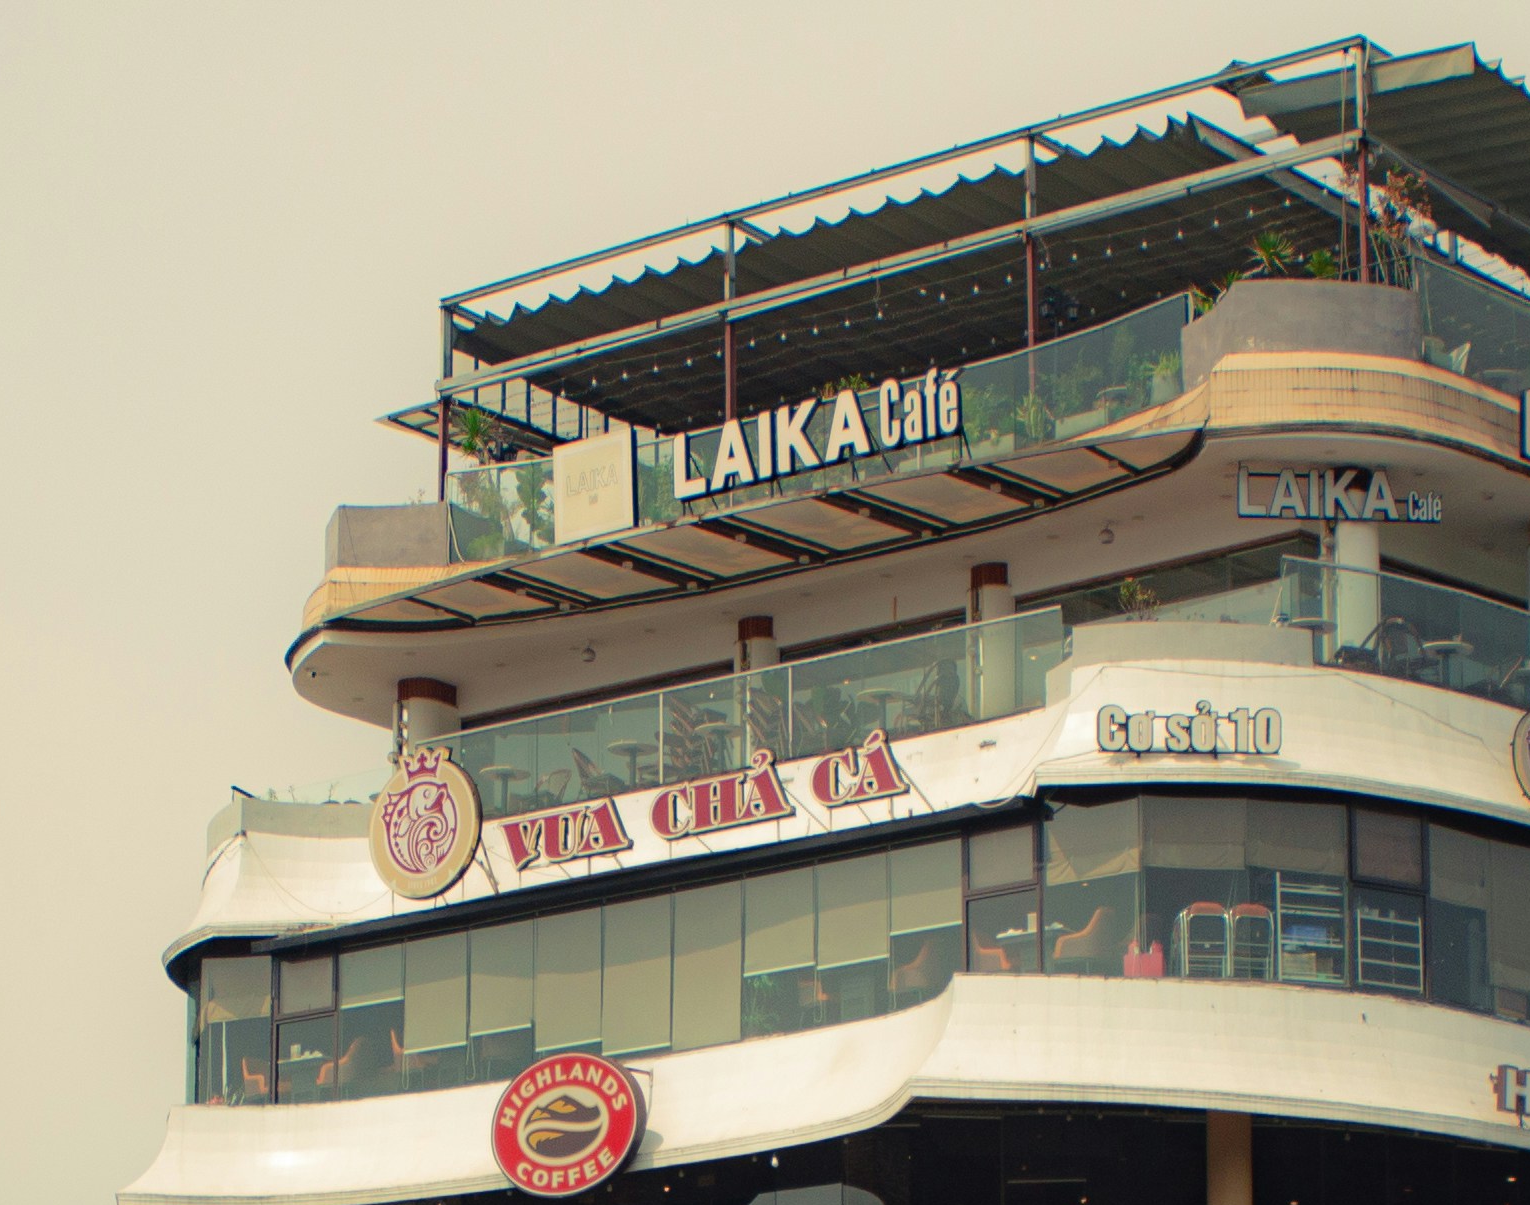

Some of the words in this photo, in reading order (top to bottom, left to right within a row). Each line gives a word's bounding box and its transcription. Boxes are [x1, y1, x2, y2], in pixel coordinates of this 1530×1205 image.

[673, 388, 871, 501] LAIKA
[877, 368, 962, 450] Café
[565, 463, 619, 497] LAIKA
[1236, 466, 1401, 522] LAIKA
[1406, 489, 1443, 524] Café
[1097, 704, 1156, 753] Cơ
[1227, 707, 1284, 755] 10
[499, 796, 634, 872] VUA
[649, 748, 796, 840] CHẢ
[810, 729, 910, 807] CÁ
[499, 1061, 629, 1131] HIGHLANDS
[515, 1146, 616, 1190] COFFEE
